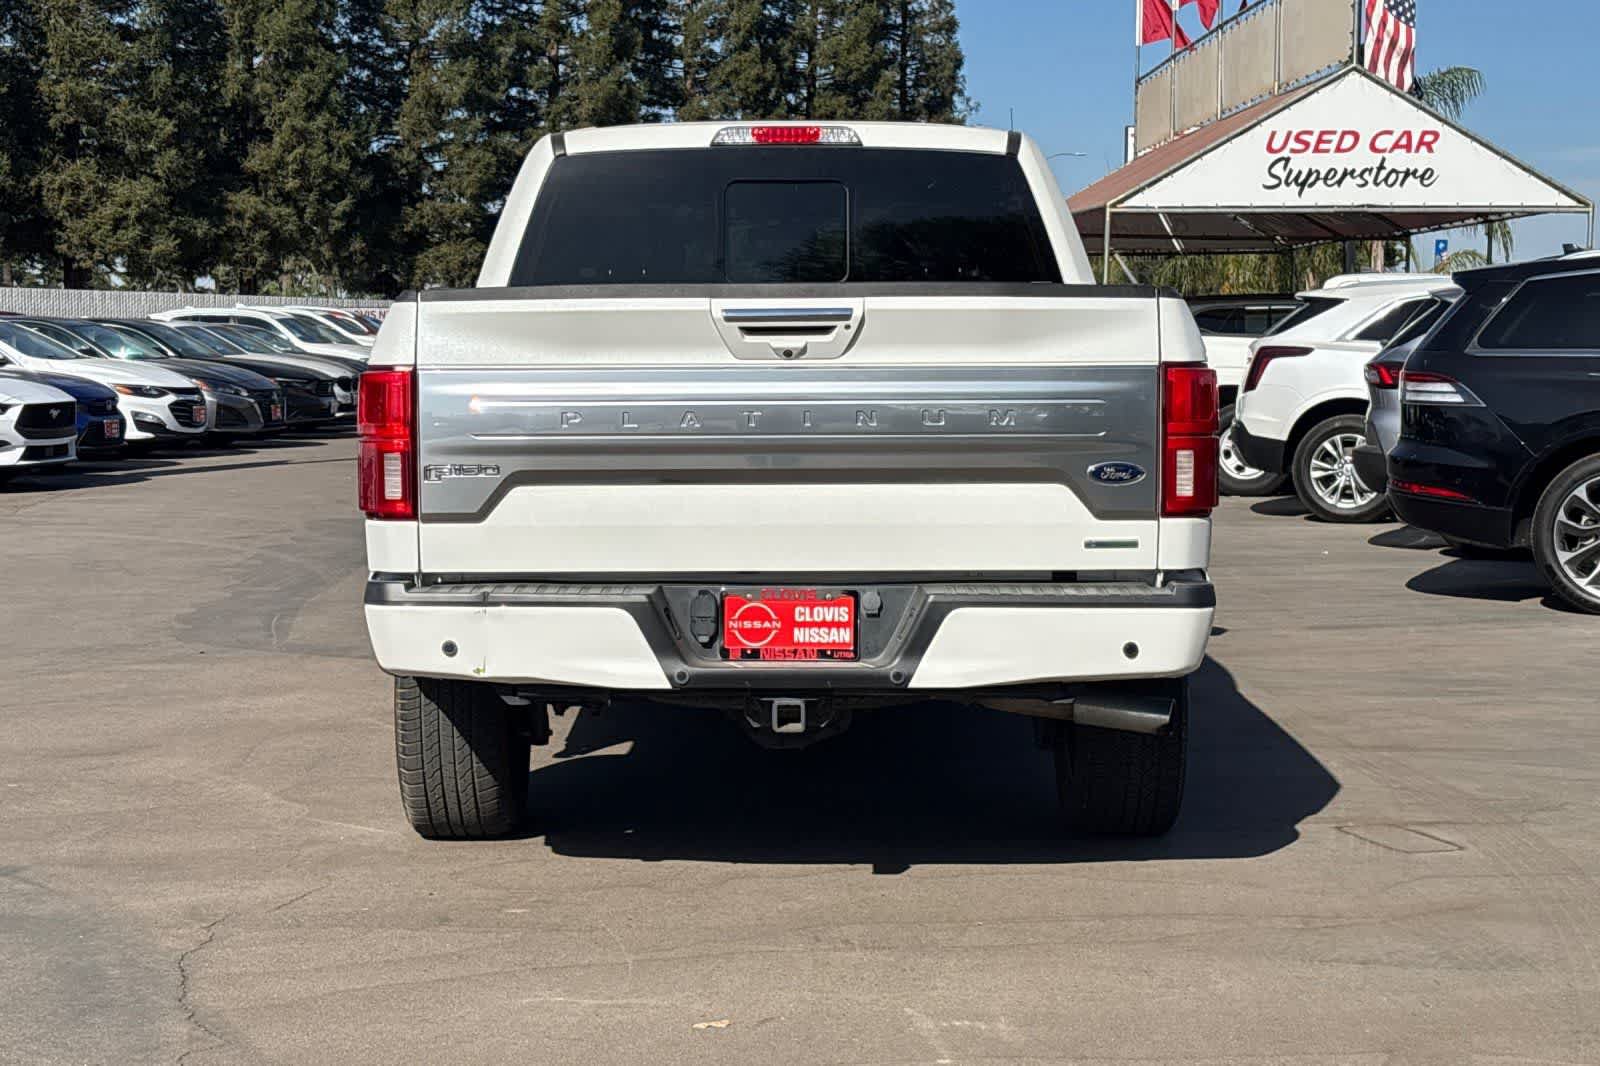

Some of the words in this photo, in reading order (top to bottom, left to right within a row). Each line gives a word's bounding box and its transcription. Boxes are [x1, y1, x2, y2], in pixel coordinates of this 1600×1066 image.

[1265, 130, 1361, 154] USED
[1369, 130, 1441, 154] CAR
[1262, 156, 1440, 198] Superstore
[561, 409, 1016, 428] PLATINUM
[794, 606, 849, 623] CLOVIS
[729, 620, 781, 629] NISSAN
[793, 627, 850, 643] NISSAN
[760, 648, 818, 660] NISSAN
